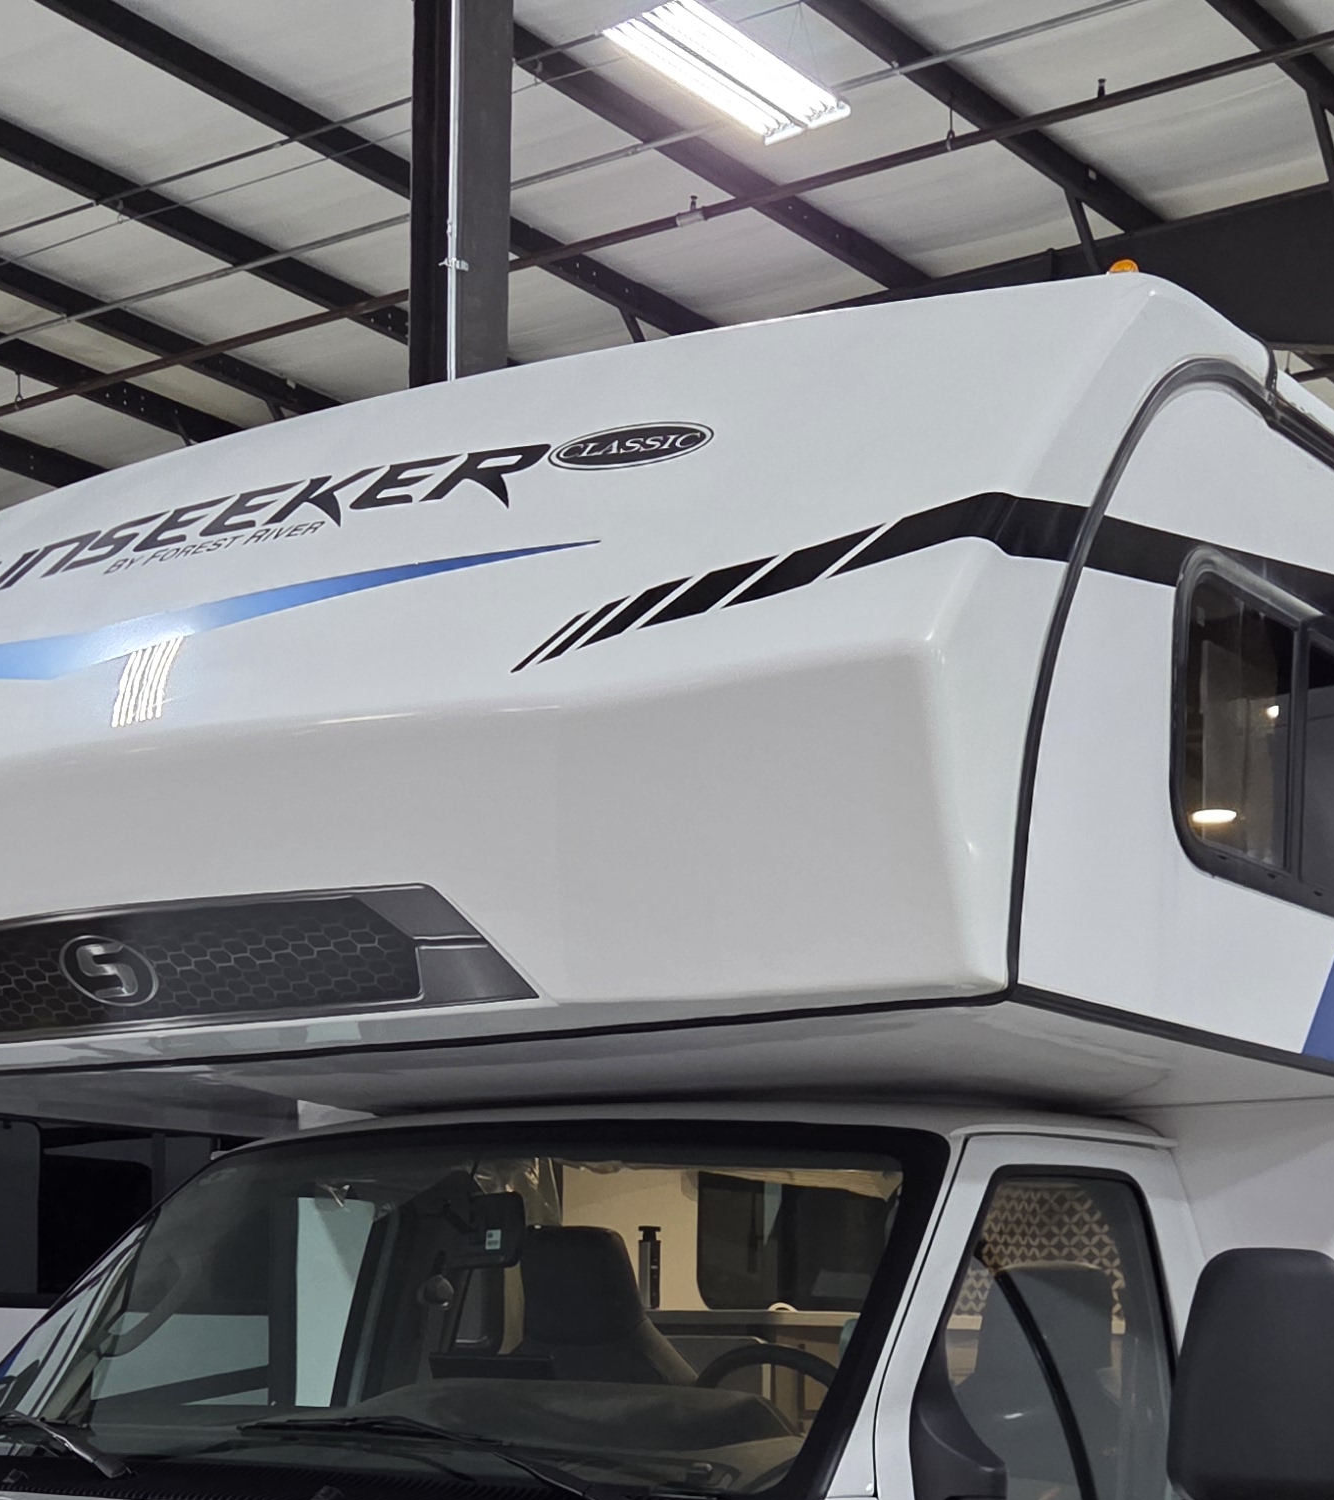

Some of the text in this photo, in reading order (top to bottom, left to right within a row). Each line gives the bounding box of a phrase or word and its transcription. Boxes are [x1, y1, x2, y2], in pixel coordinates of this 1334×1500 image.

[558, 431, 702, 460] CLASSIC
[102, 520, 326, 576] BY FOREST RIVER
